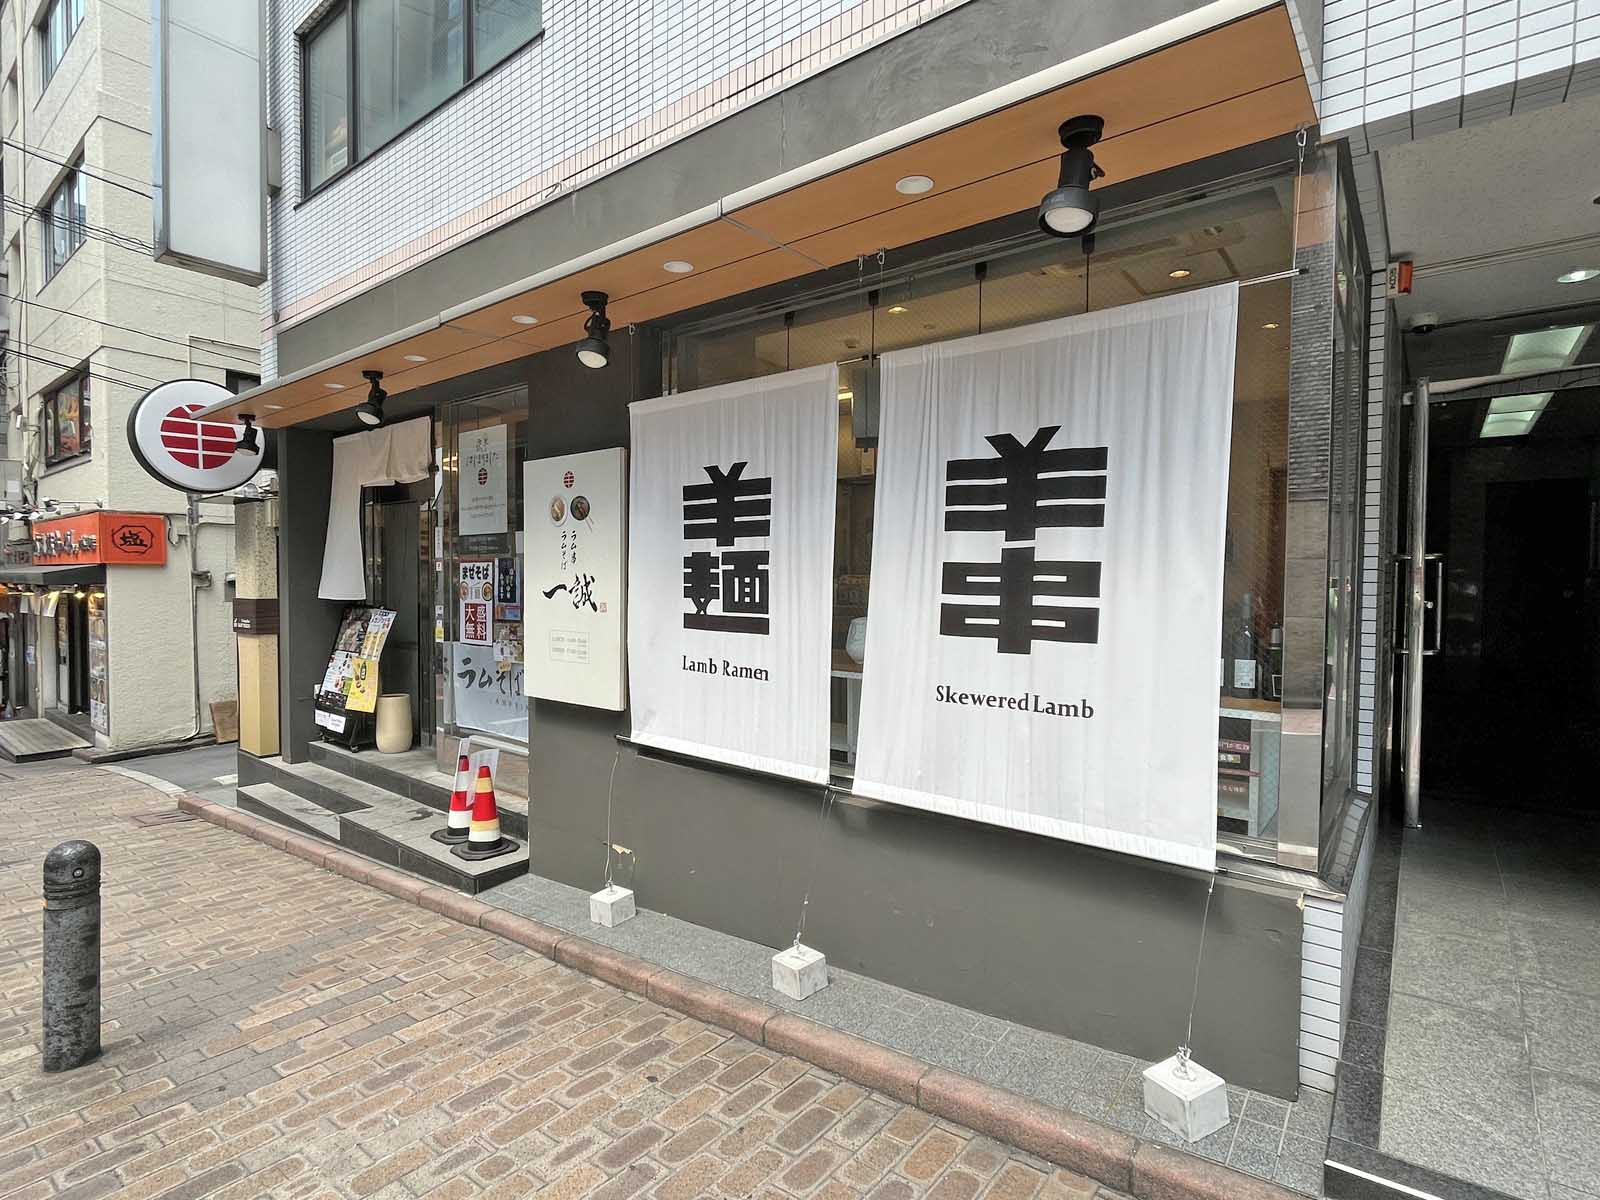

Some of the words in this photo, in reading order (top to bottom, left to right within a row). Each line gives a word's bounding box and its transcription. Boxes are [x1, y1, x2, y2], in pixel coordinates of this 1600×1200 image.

[462, 564, 490, 581] まぜそば
[542, 573, 598, 613] 一誠
[682, 655, 717, 675] Lamb
[722, 659, 769, 681] Ramen
[1033, 694, 1095, 719] Lamb
